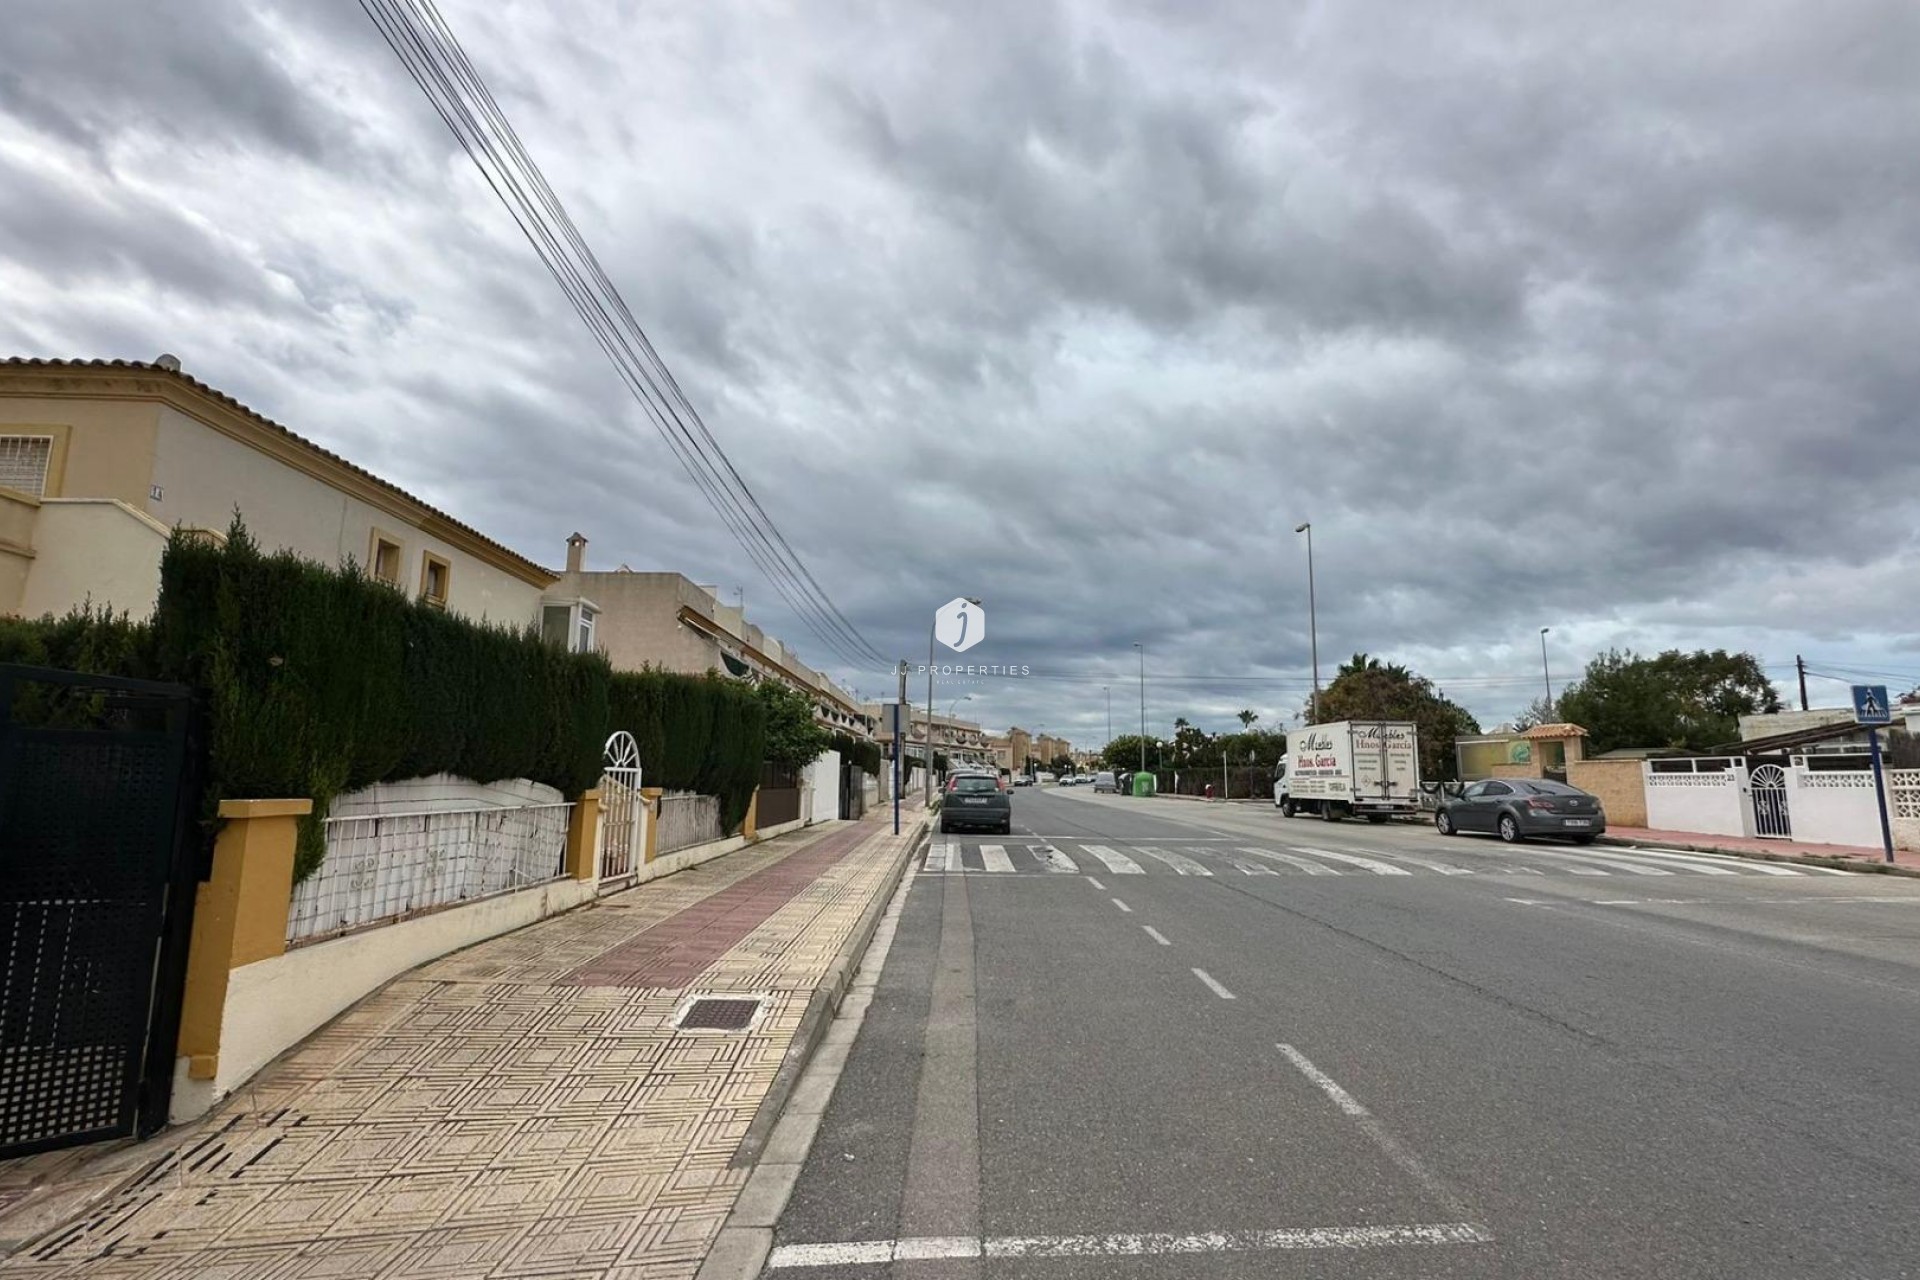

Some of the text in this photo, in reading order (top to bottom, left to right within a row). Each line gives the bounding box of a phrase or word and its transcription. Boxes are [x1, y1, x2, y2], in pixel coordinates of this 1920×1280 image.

[1358, 727, 1405, 739] Muebles
[1300, 732, 1333, 751] Muebles
[1384, 740, 1412, 749] García
[1315, 753, 1336, 768] García
